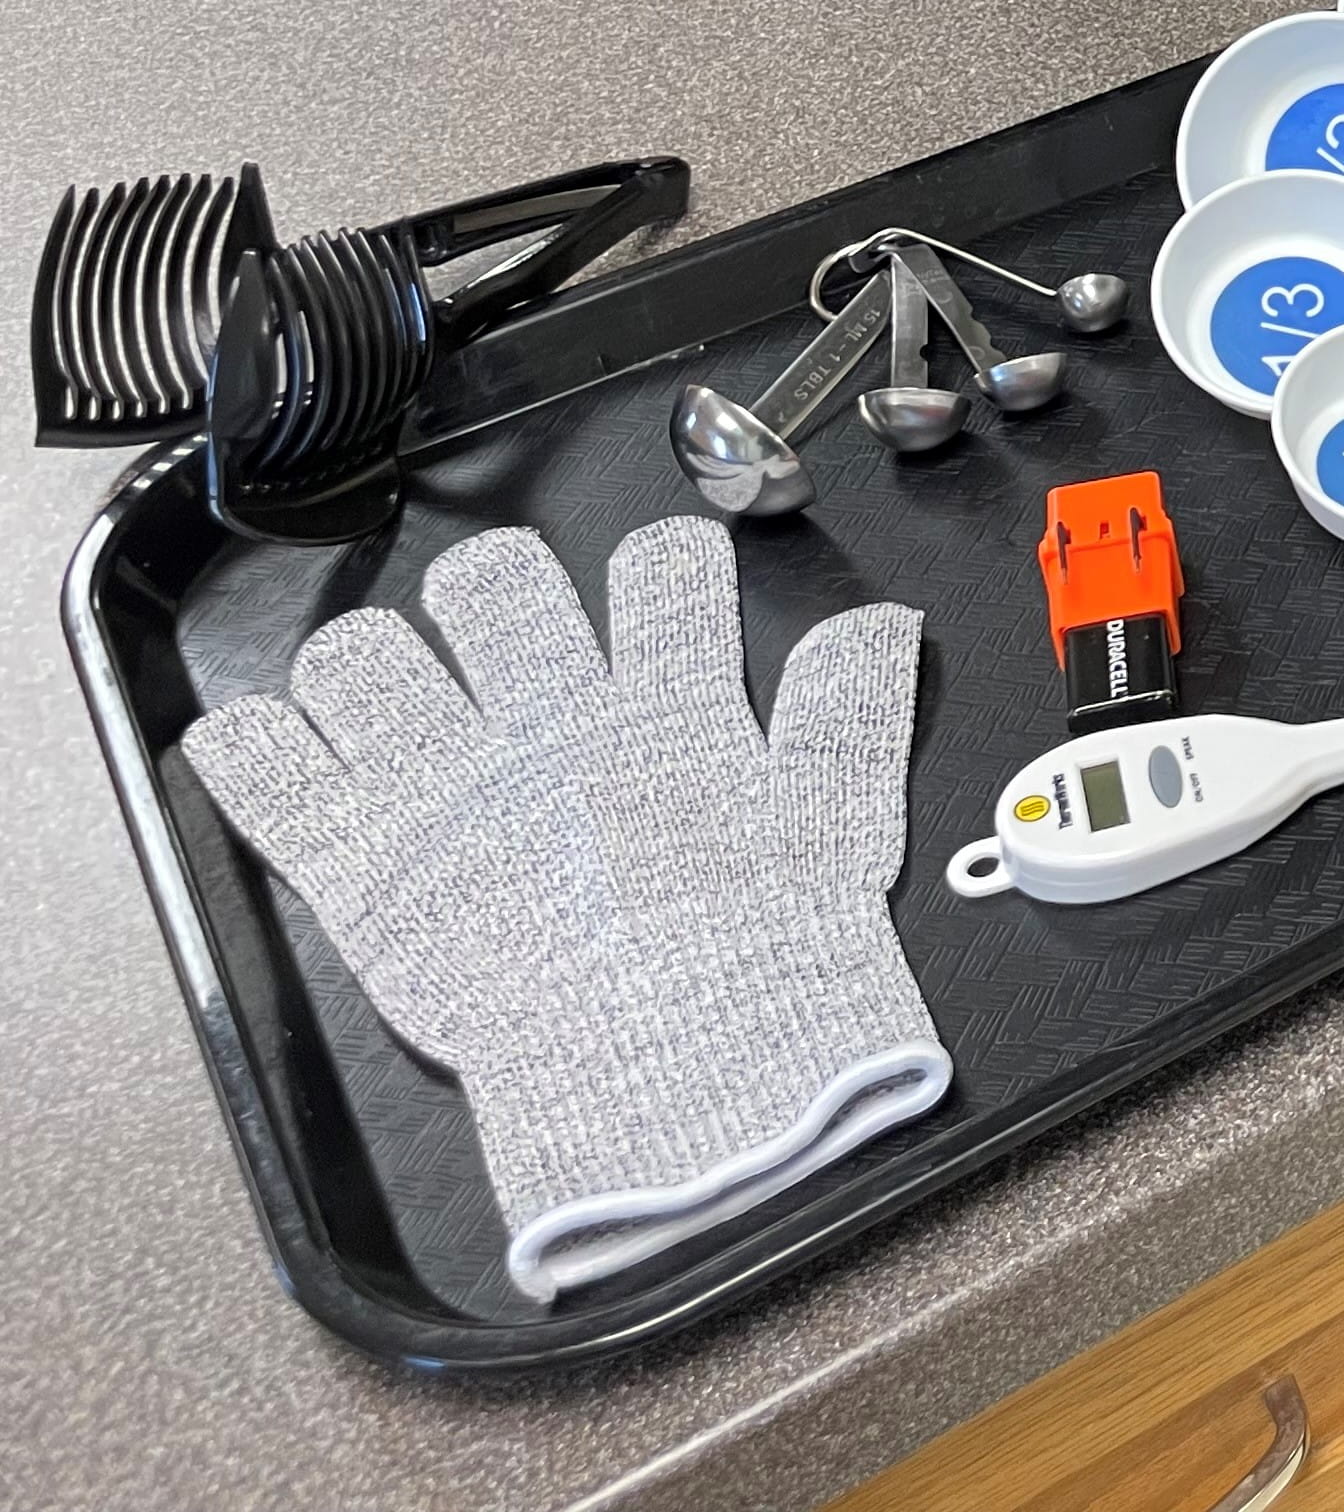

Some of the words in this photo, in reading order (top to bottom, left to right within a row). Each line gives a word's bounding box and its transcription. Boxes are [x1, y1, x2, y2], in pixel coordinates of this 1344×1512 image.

[863, 309, 881, 324] 15
[793, 365, 832, 401] TBLS
[1106, 618, 1129, 699] DURACELL
